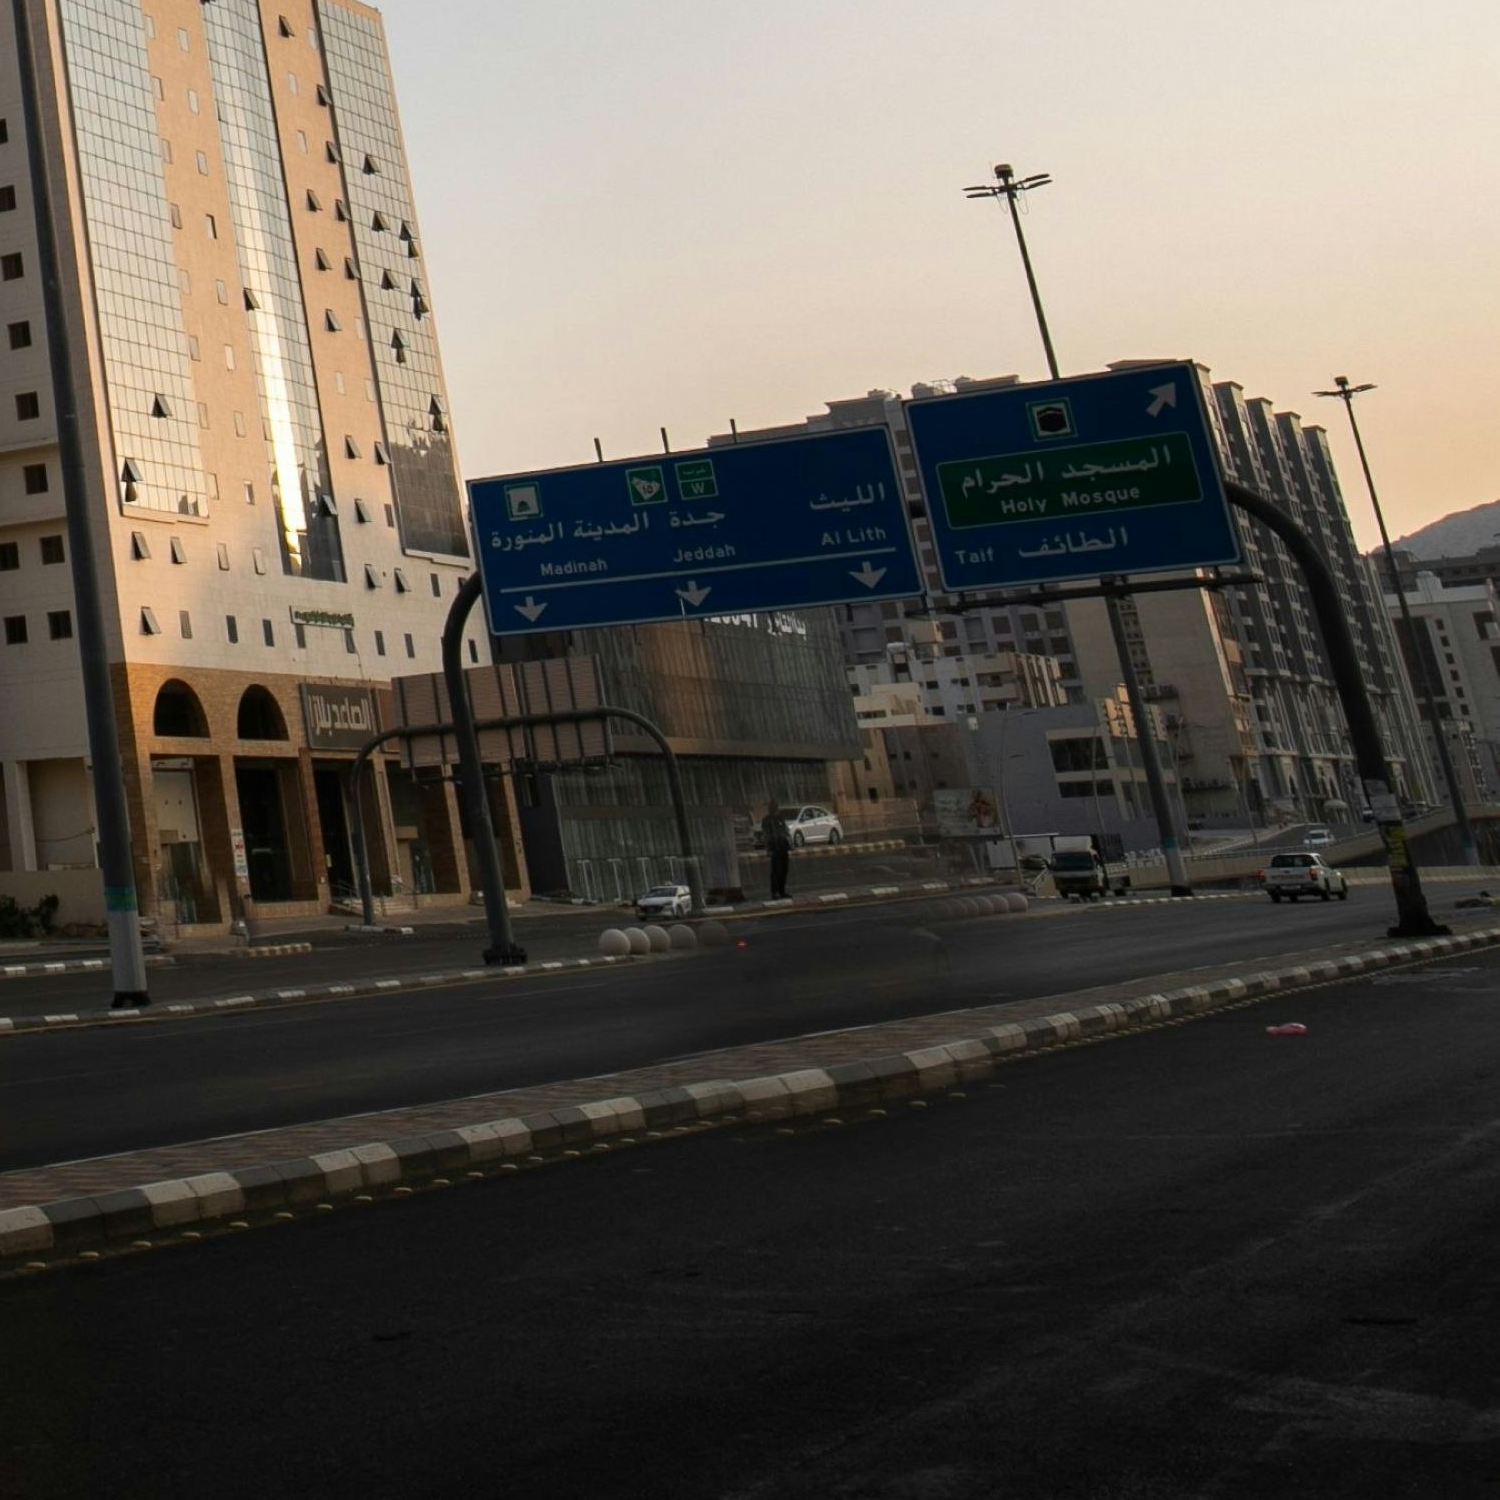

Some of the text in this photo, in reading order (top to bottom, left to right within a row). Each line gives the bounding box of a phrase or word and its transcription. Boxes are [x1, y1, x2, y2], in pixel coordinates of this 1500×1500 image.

[960, 444, 1172, 499] المسجد الحرام
[690, 481, 705, 494] W
[809, 481, 886, 512] الليث
[1000, 485, 1141, 514] Holy Mosque
[669, 510, 726, 529] جدة
[491, 510, 649, 552] المدينة المنورة
[821, 526, 887, 546] Al Lith
[1017, 526, 1129, 558] الطائف
[673, 544, 736, 563] Jeddah
[954, 546, 995, 565] Taif
[540, 557, 608, 577] Madinah
